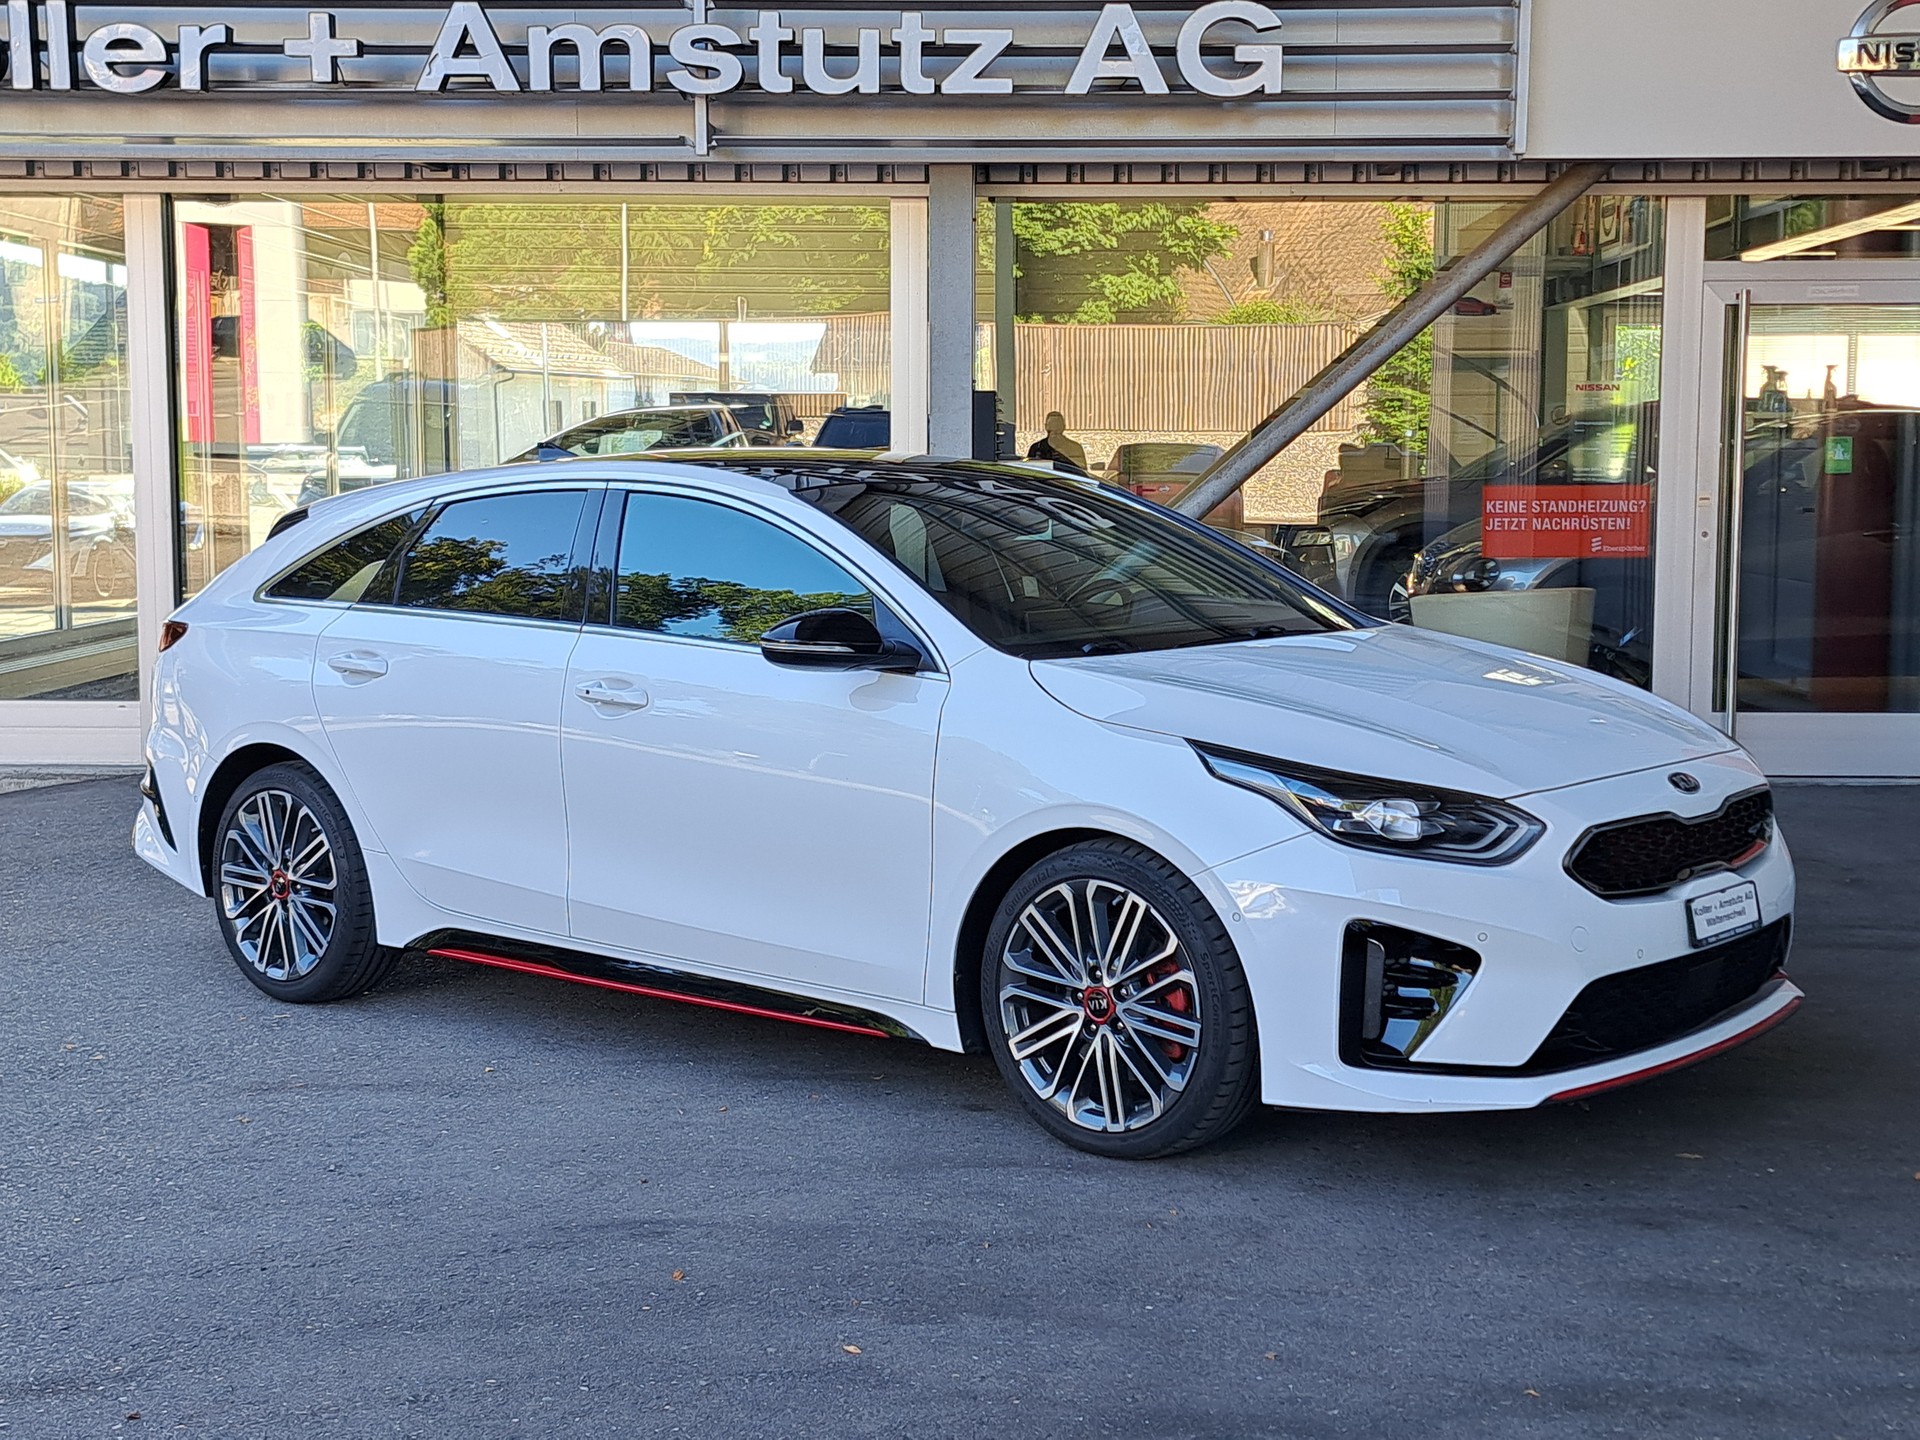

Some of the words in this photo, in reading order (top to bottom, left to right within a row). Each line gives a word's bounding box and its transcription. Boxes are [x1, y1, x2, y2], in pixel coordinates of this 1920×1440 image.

[0, 0, 227, 94] ller
[414, 1, 1014, 95] Amstutz
[1064, 0, 1284, 97] AG
[1857, 41, 1920, 65] NIS
[1575, 383, 1621, 392] NISSAN
[1485, 499, 1528, 514] KEINE
[1531, 499, 1647, 513] STANDHEIZUNG?
[1485, 517, 1528, 531] JETZT
[1532, 515, 1632, 531] NACHRÜSTEN!
